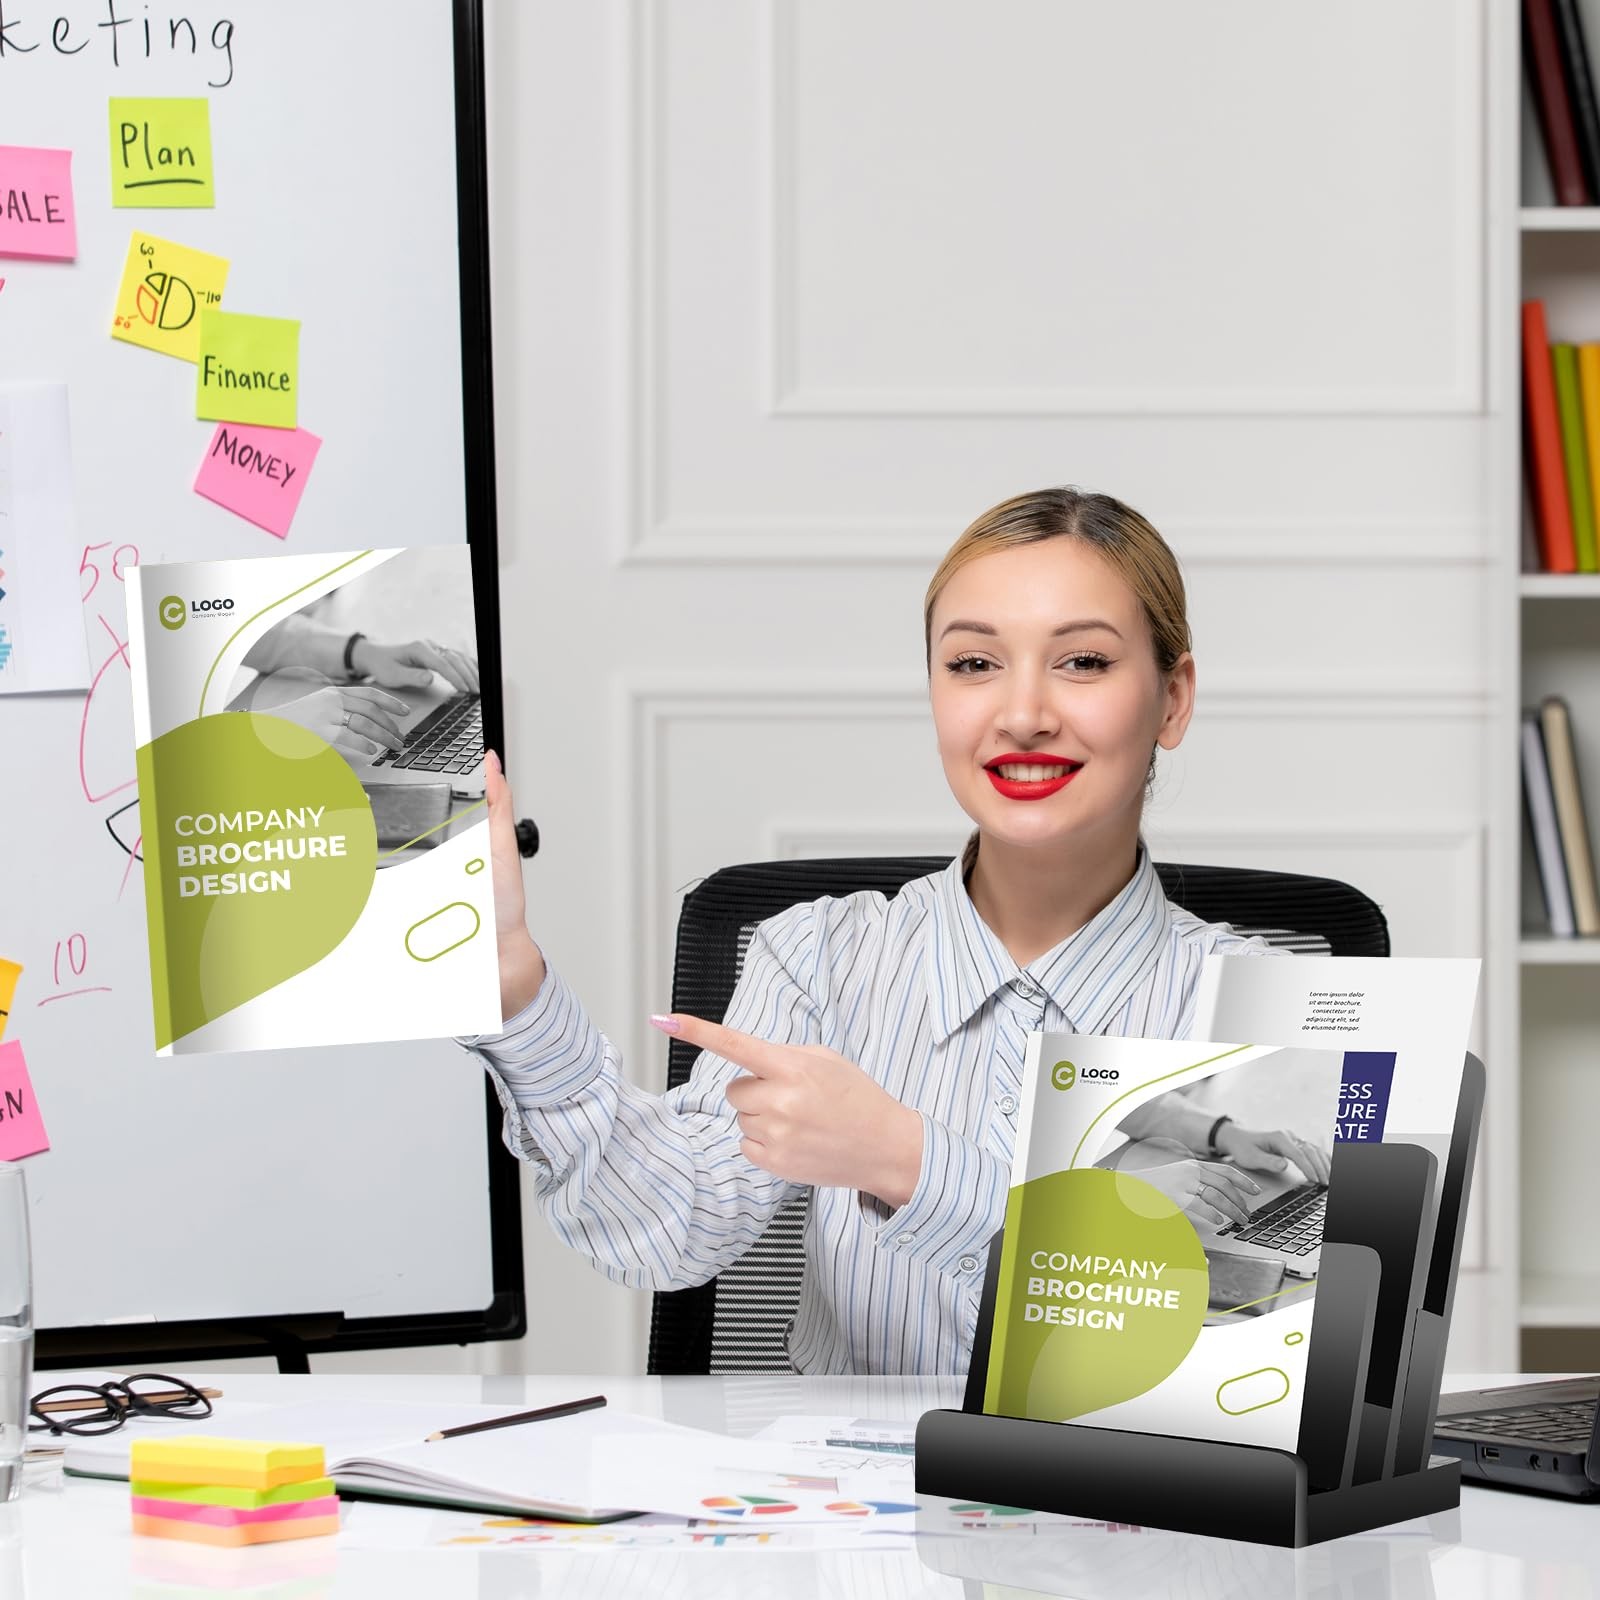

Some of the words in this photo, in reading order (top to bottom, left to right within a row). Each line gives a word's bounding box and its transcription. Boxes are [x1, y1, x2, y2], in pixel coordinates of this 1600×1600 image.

[119, 122, 196, 169] Plan
[140, 242, 155, 256] 60
[203, 355, 291, 393] Finance
[211, 428, 297, 489] MONEY
[191, 598, 235, 612] LOGO
[174, 806, 325, 837] COMPANY
[176, 835, 347, 868] BROCHURE
[178, 869, 292, 898] DESIGN
[54, 933, 87, 985] 10
[1081, 1068, 1120, 1080] LOGO
[1030, 1250, 1167, 1281] COMPANY
[1026, 1276, 1181, 1310] BROCHURE
[1024, 1304, 1125, 1331] DESIGN
